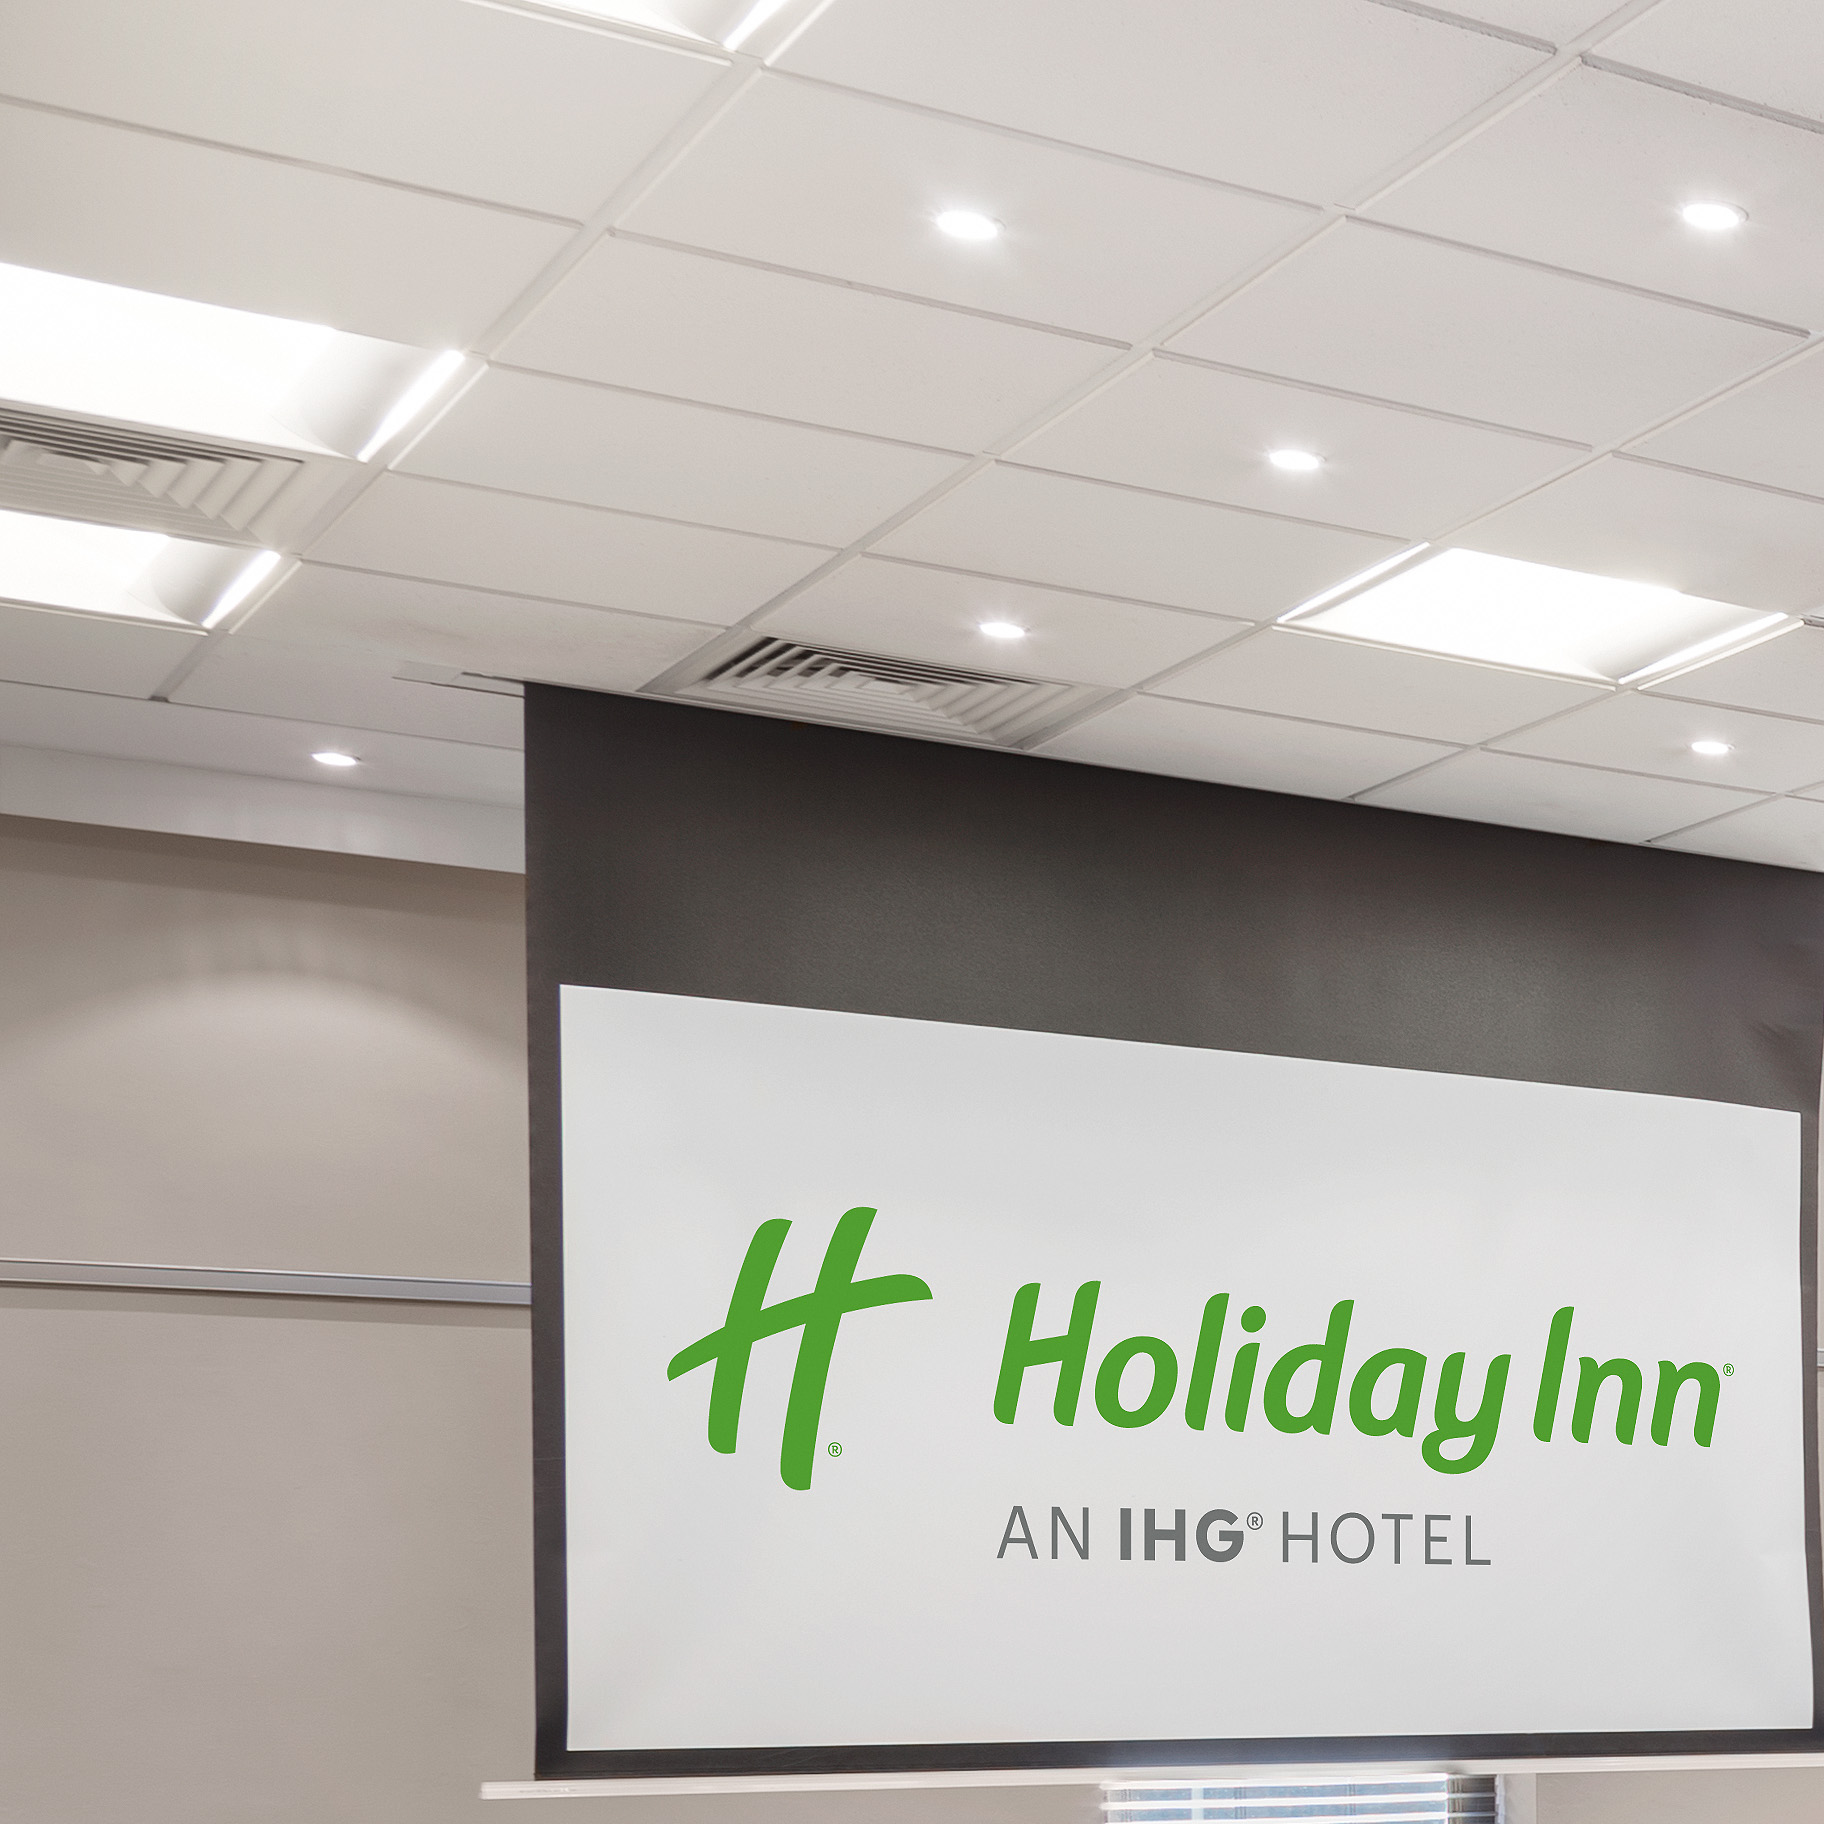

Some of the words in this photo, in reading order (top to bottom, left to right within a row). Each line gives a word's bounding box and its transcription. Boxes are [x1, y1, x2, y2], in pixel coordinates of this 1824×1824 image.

[992, 1279, 1512, 1475] Holiday
[996, 1506, 1090, 1560] AN
[1281, 1512, 1491, 1566] HOTEL
